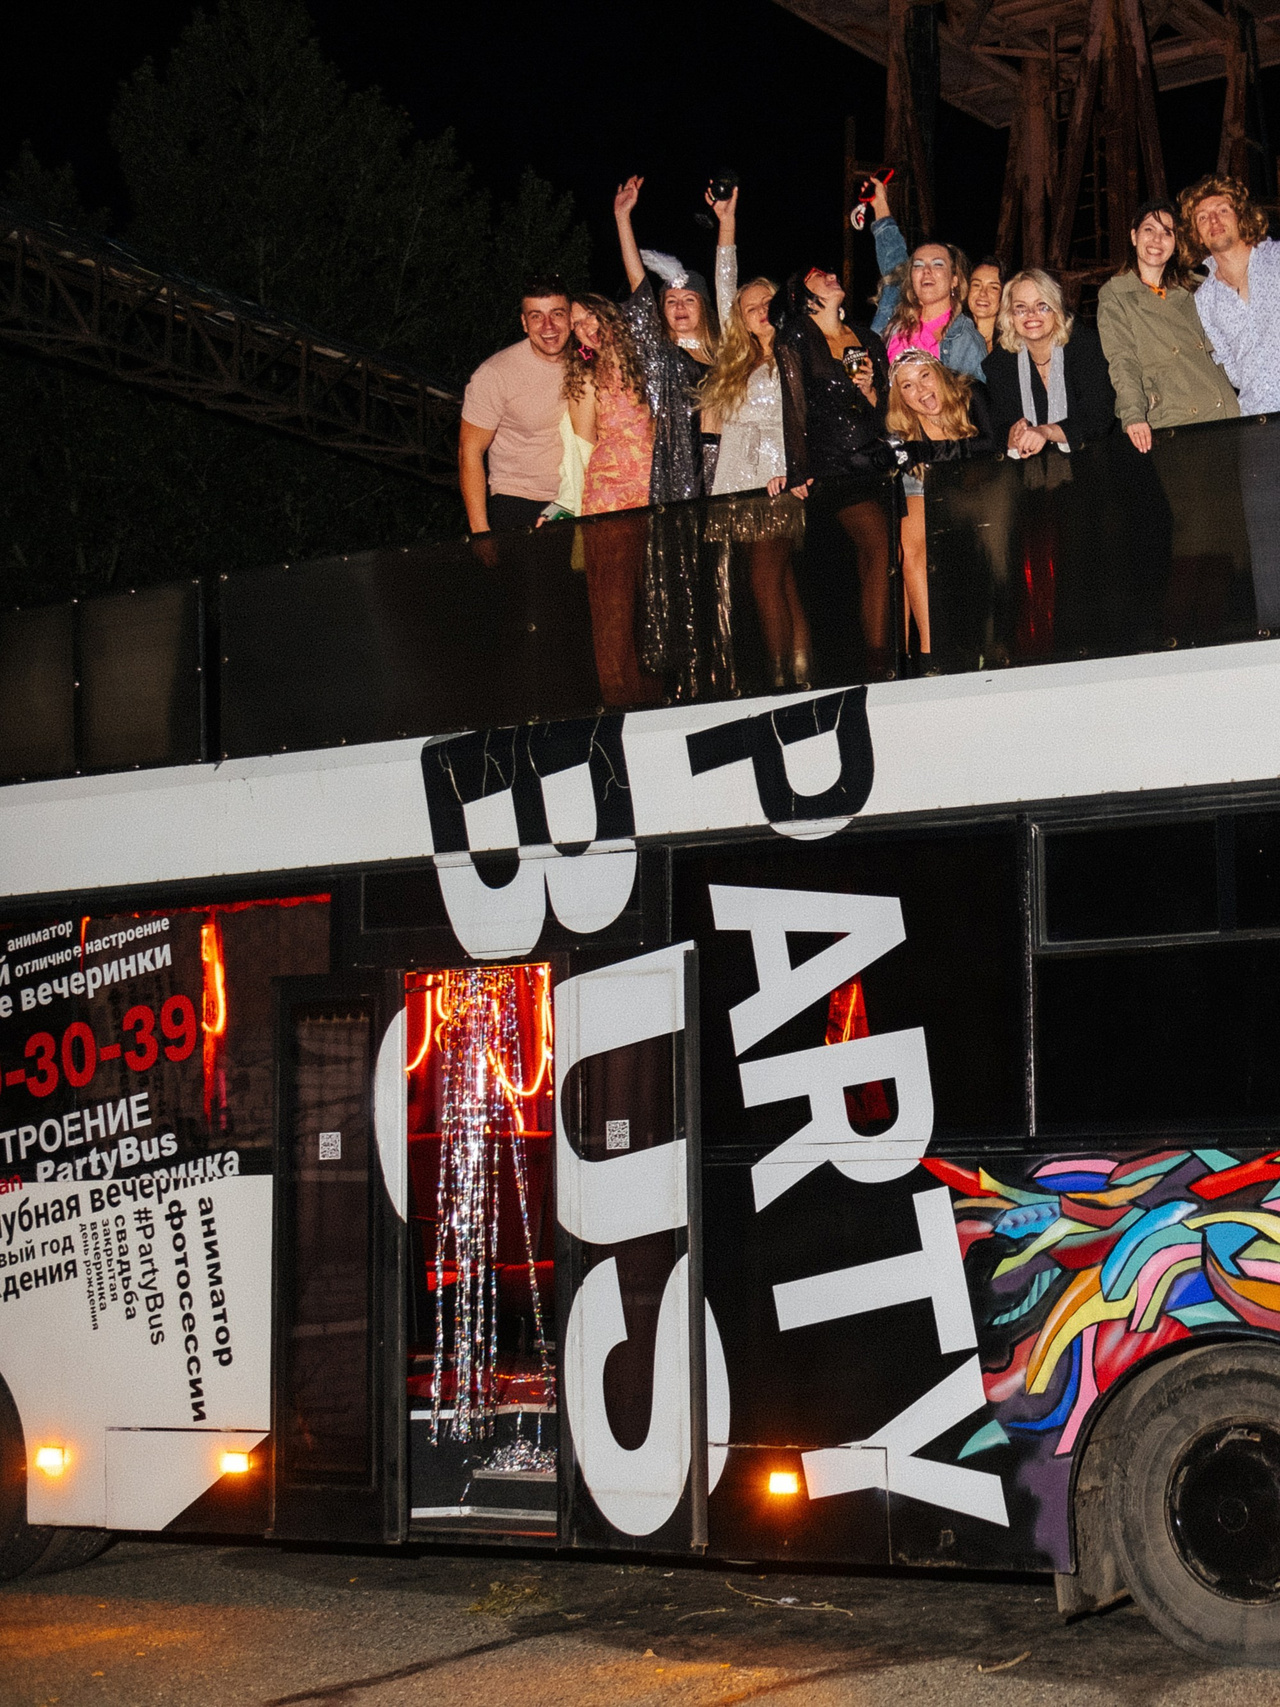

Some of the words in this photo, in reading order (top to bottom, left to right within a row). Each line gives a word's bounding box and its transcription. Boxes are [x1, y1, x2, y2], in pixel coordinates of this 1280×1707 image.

[7, 920, 73, 952] аниматор
[15, 945, 82, 977] отличное
[86, 917, 170, 949] настроение
[20, 943, 173, 1012] вечеринки
[0, 995, 198, 1098] -30-39
[0, 1092, 152, 1164] ТРОЕНИЕ
[421, 711, 731, 1537] BUS
[686, 685, 1010, 1527] PARTY
[0, 1194, 81, 1246] убная
[89, 1150, 240, 1214] вечеринка
[36, 1132, 178, 1183] PartyBus
[0, 1258, 78, 1303] дения
[41, 1235, 75, 1257] год
[79, 1222, 90, 1256] день
[90, 1221, 107, 1311] вечеринка
[102, 1218, 118, 1303] закрытая
[114, 1214, 139, 1321] свадьба
[133, 1207, 165, 1346] #PartyBus
[198, 1196, 234, 1367] аниматор
[83, 1260, 99, 1331] рождения
[164, 1199, 207, 1423] фотосессии
